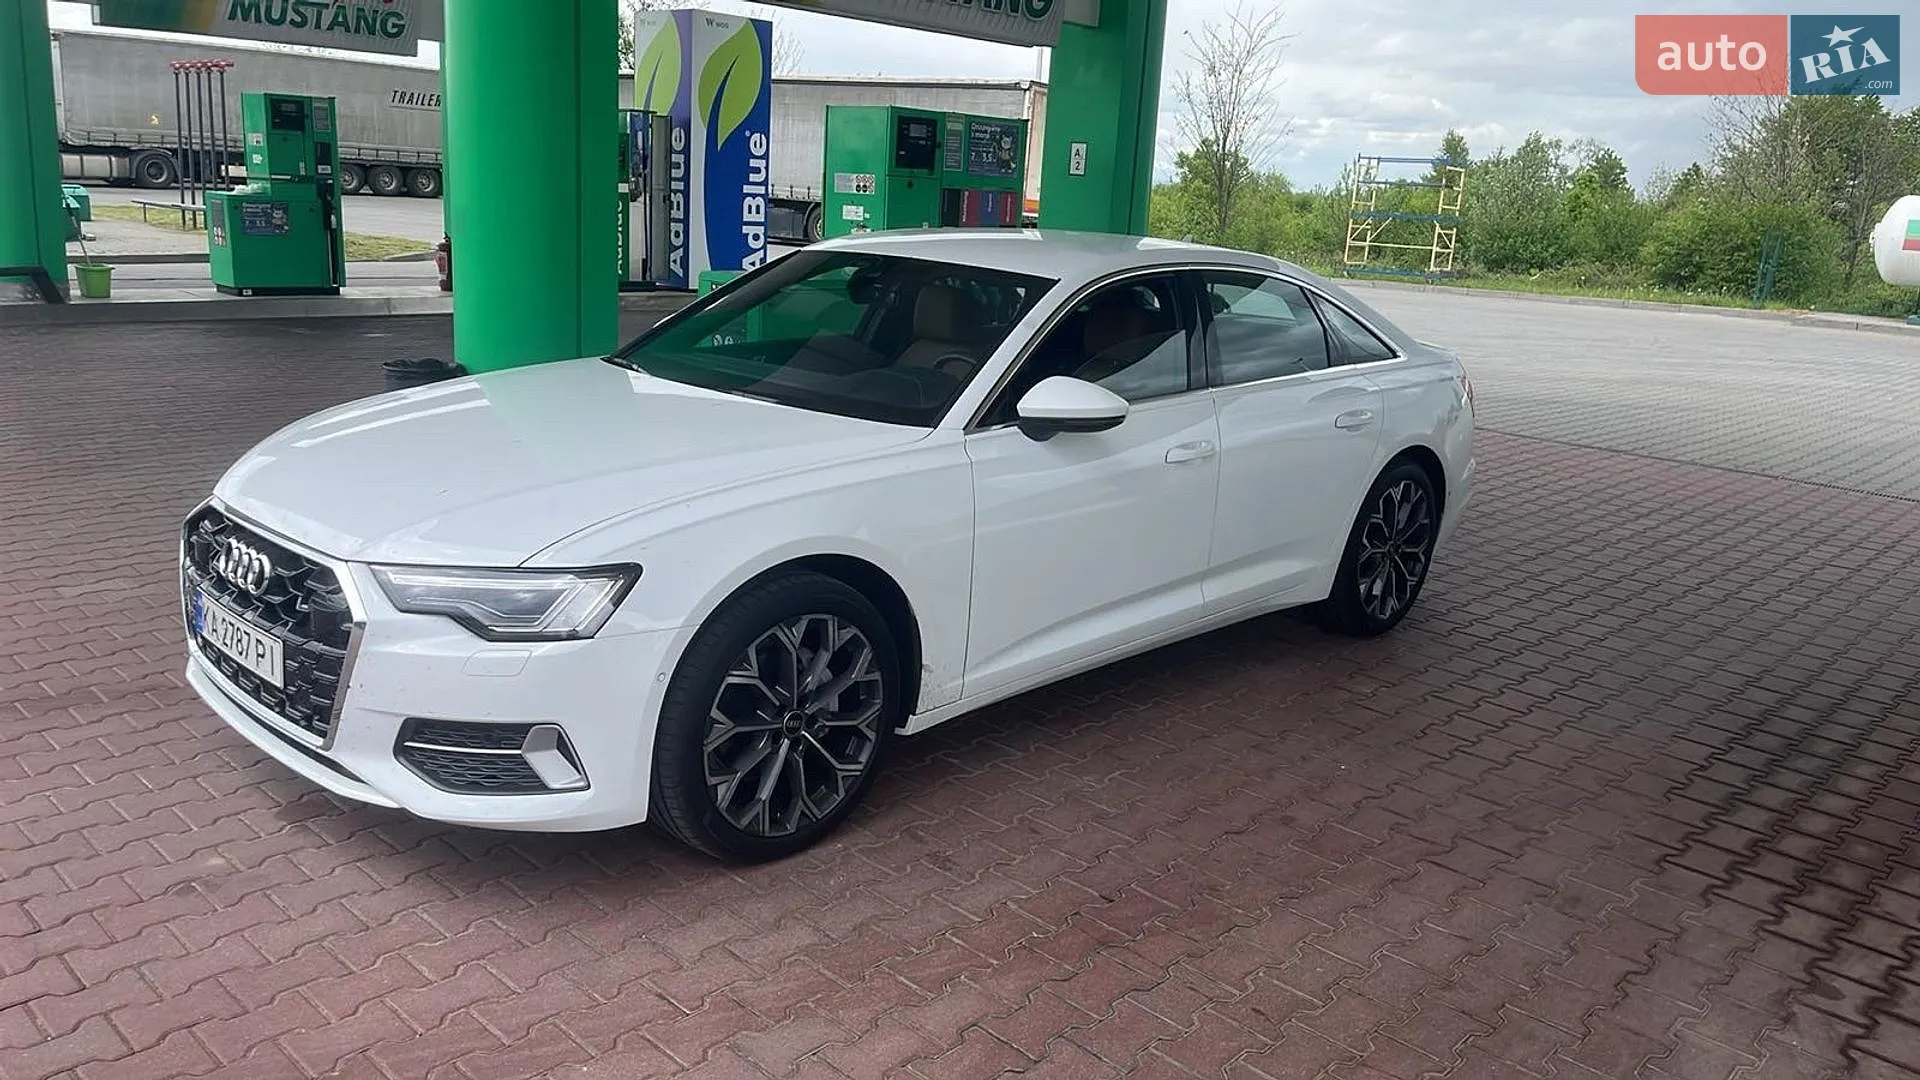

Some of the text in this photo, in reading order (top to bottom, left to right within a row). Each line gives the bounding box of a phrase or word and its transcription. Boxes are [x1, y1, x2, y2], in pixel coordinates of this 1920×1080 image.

[228, 0, 406, 38] MUSTANG
[668, 127, 686, 278] AdBlue
[221, 617, 250, 660] 2787
[255, 637, 274, 678] PI
